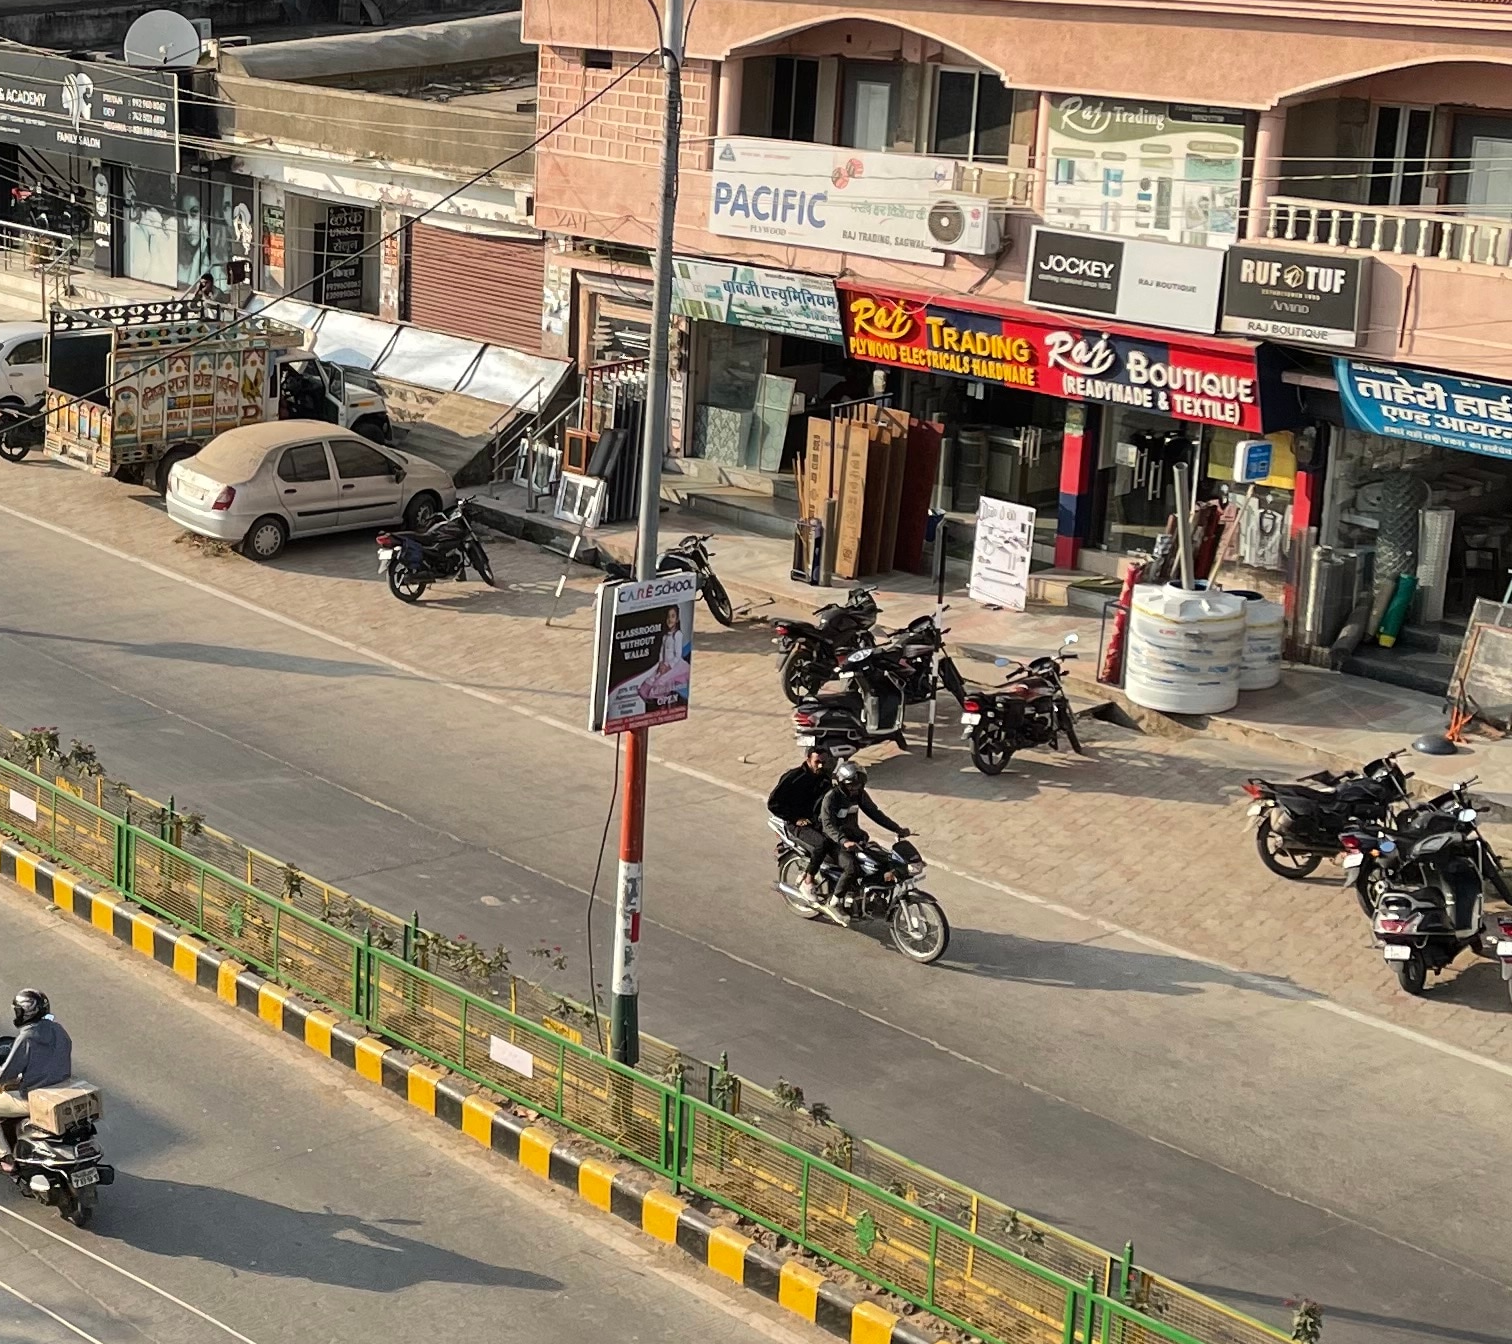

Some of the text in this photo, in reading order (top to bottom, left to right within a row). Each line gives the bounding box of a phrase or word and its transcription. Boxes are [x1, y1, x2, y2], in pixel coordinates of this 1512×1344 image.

[6, 89, 47, 107] ACADEMY
[1059, 96, 1112, 134] Raj
[1113, 106, 1165, 130] Trading
[56, 131, 101, 149] FAMILY SALON
[714, 181, 828, 229] PACIFIC
[93, 220, 111, 236] MEN
[750, 225, 787, 236] PLYWOOD
[842, 230, 856, 240] RAJ
[1039, 254, 1115, 278] JOCKEY
[1240, 258, 1346, 293] RUF TUF
[1138, 278, 1197, 293] RAJ BOUTIQUE
[850, 298, 913, 339] Raj
[1248, 321, 1329, 340] RAJ BOUTIQUE
[850, 336, 1036, 386] PLYWOOD ELECTRICALS HARDWARE
[1044, 331, 1116, 375] Raj
[1062, 372, 1240, 425] (READYMADE & TEXTILE)
[1354, 376, 1448, 412] ताहेरी
[1380, 404, 1432, 427] एण्ड
[619, 578, 694, 603] CARE SCHOOL
[615, 623, 662, 640] CLASSROOM
[620, 636, 656, 650] WITHOUT
[624, 648, 650, 661] WALLS
